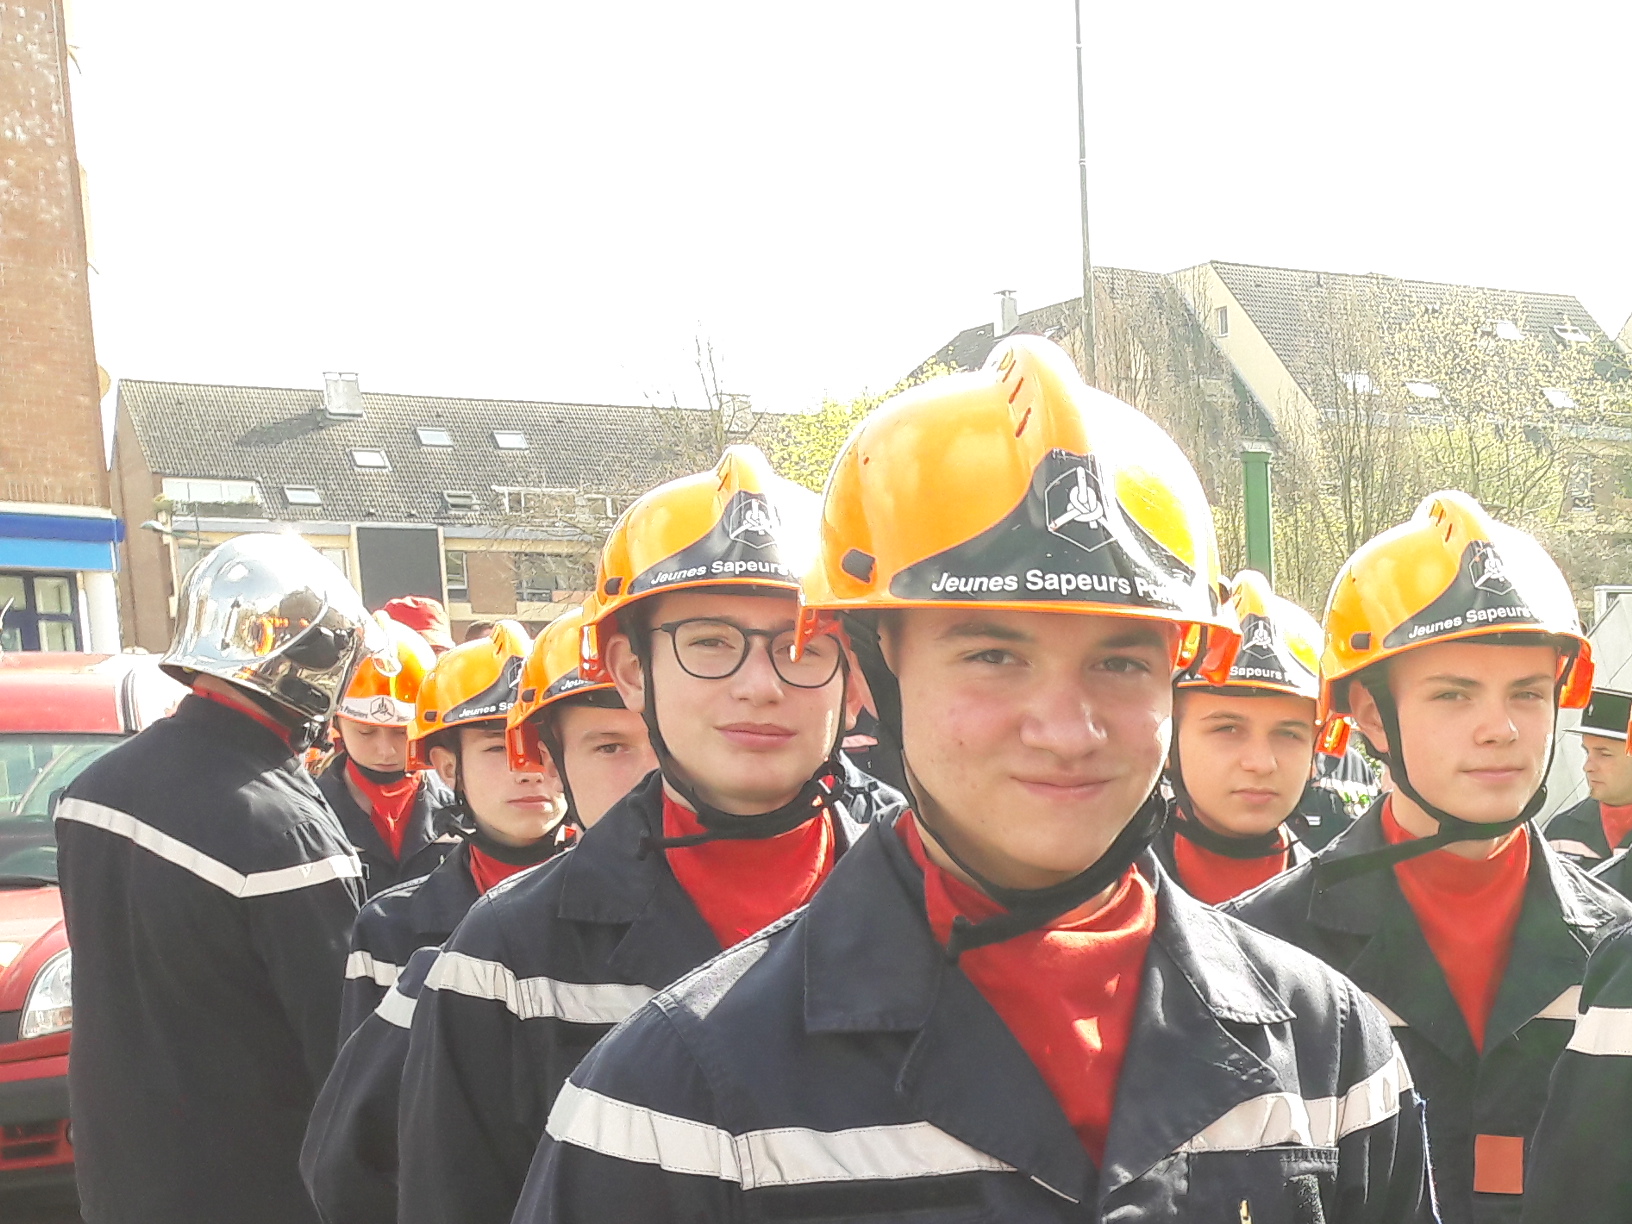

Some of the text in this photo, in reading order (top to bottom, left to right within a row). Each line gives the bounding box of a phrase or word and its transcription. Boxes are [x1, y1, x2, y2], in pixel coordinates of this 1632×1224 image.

[651, 560, 789, 585] Jeunes Sapeurs
[931, 572, 1018, 593] Jeunes
[1025, 569, 1132, 596] Sapeurs
[1408, 606, 1530, 639] Jeunes Sapeurs
[1229, 666, 1282, 680] Sapeurs
[459, 704, 496, 718] Jeunes
